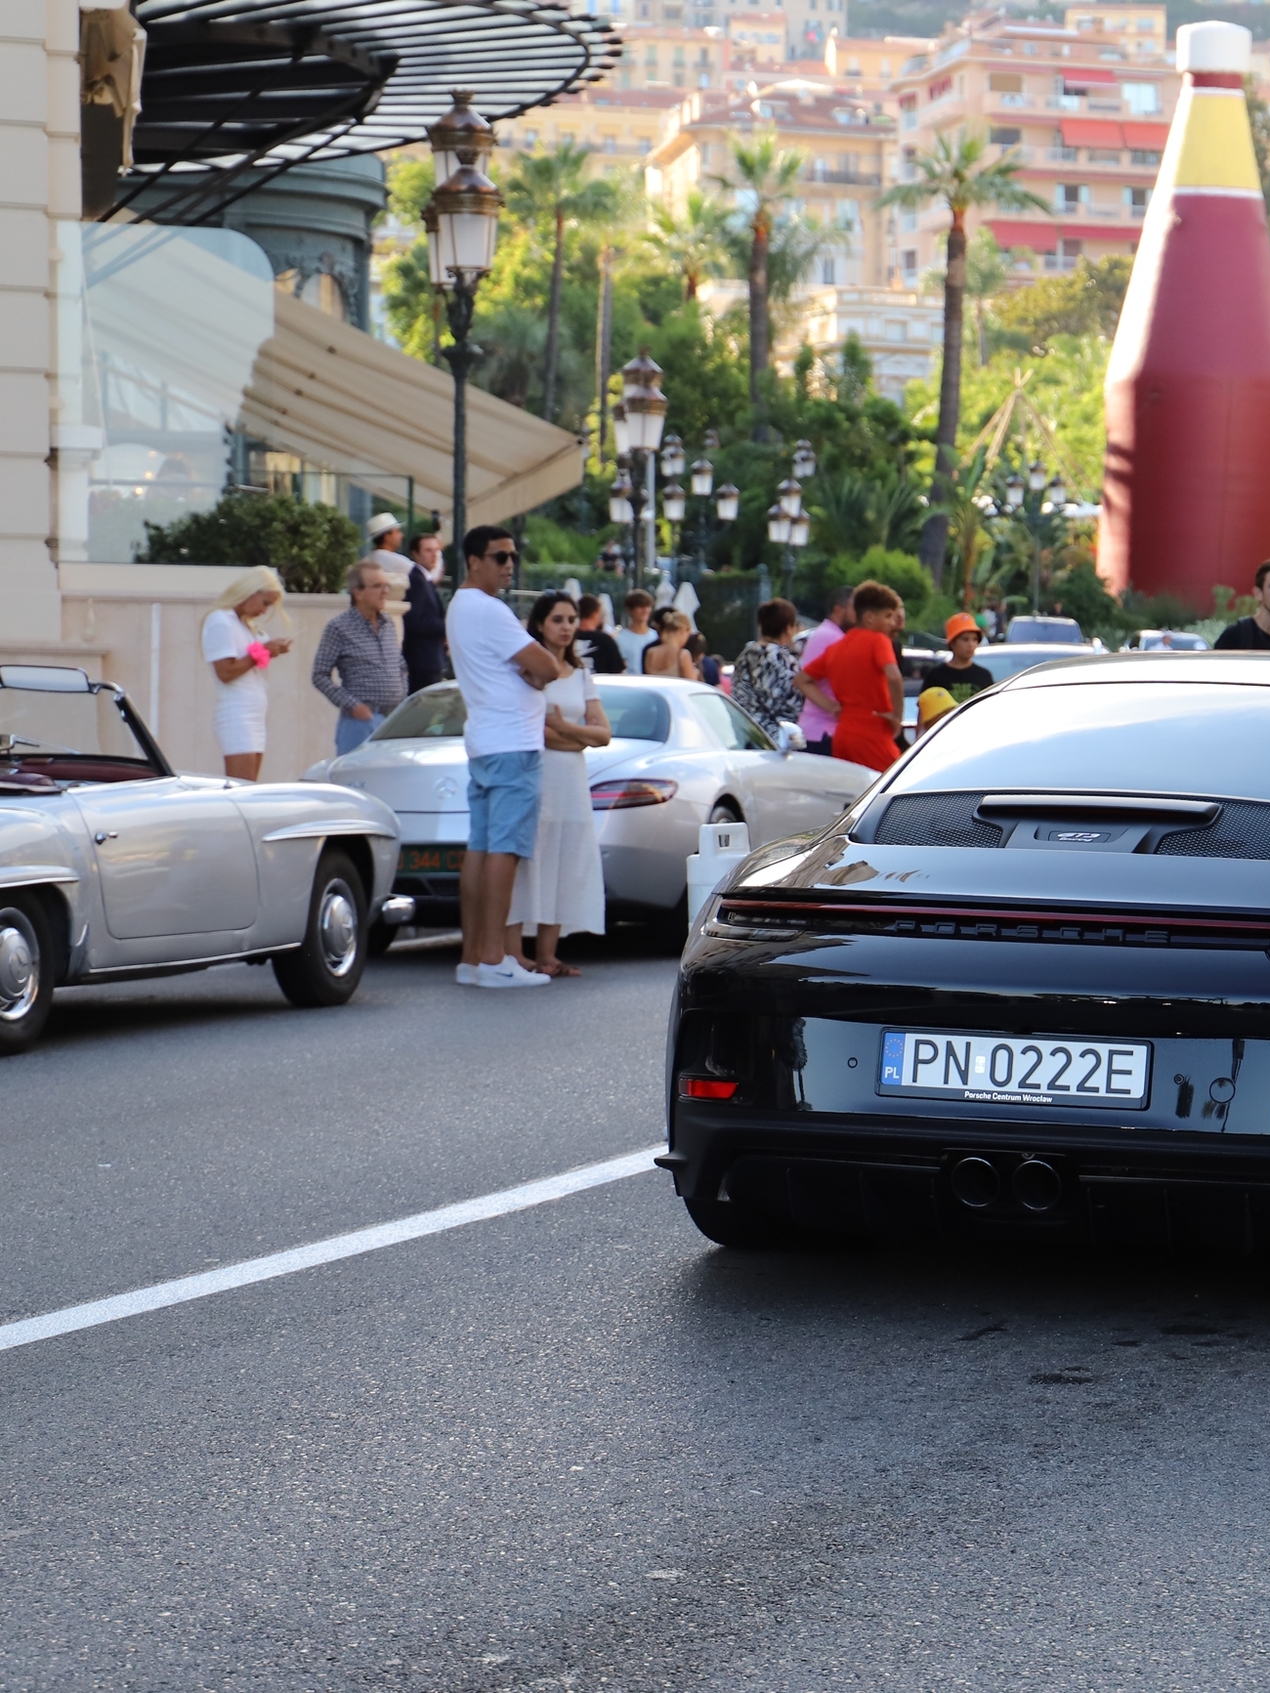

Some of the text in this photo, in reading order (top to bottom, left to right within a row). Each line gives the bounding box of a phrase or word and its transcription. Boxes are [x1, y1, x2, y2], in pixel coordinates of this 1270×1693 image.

[409, 850, 440, 870] 344
[895, 920, 1169, 943] PORSCHE
[884, 1066, 900, 1079] PL
[912, 1039, 1135, 1095] PN 0222E
[964, 1090, 991, 1099] Porsche
[992, 1092, 1021, 1101] Centrum
